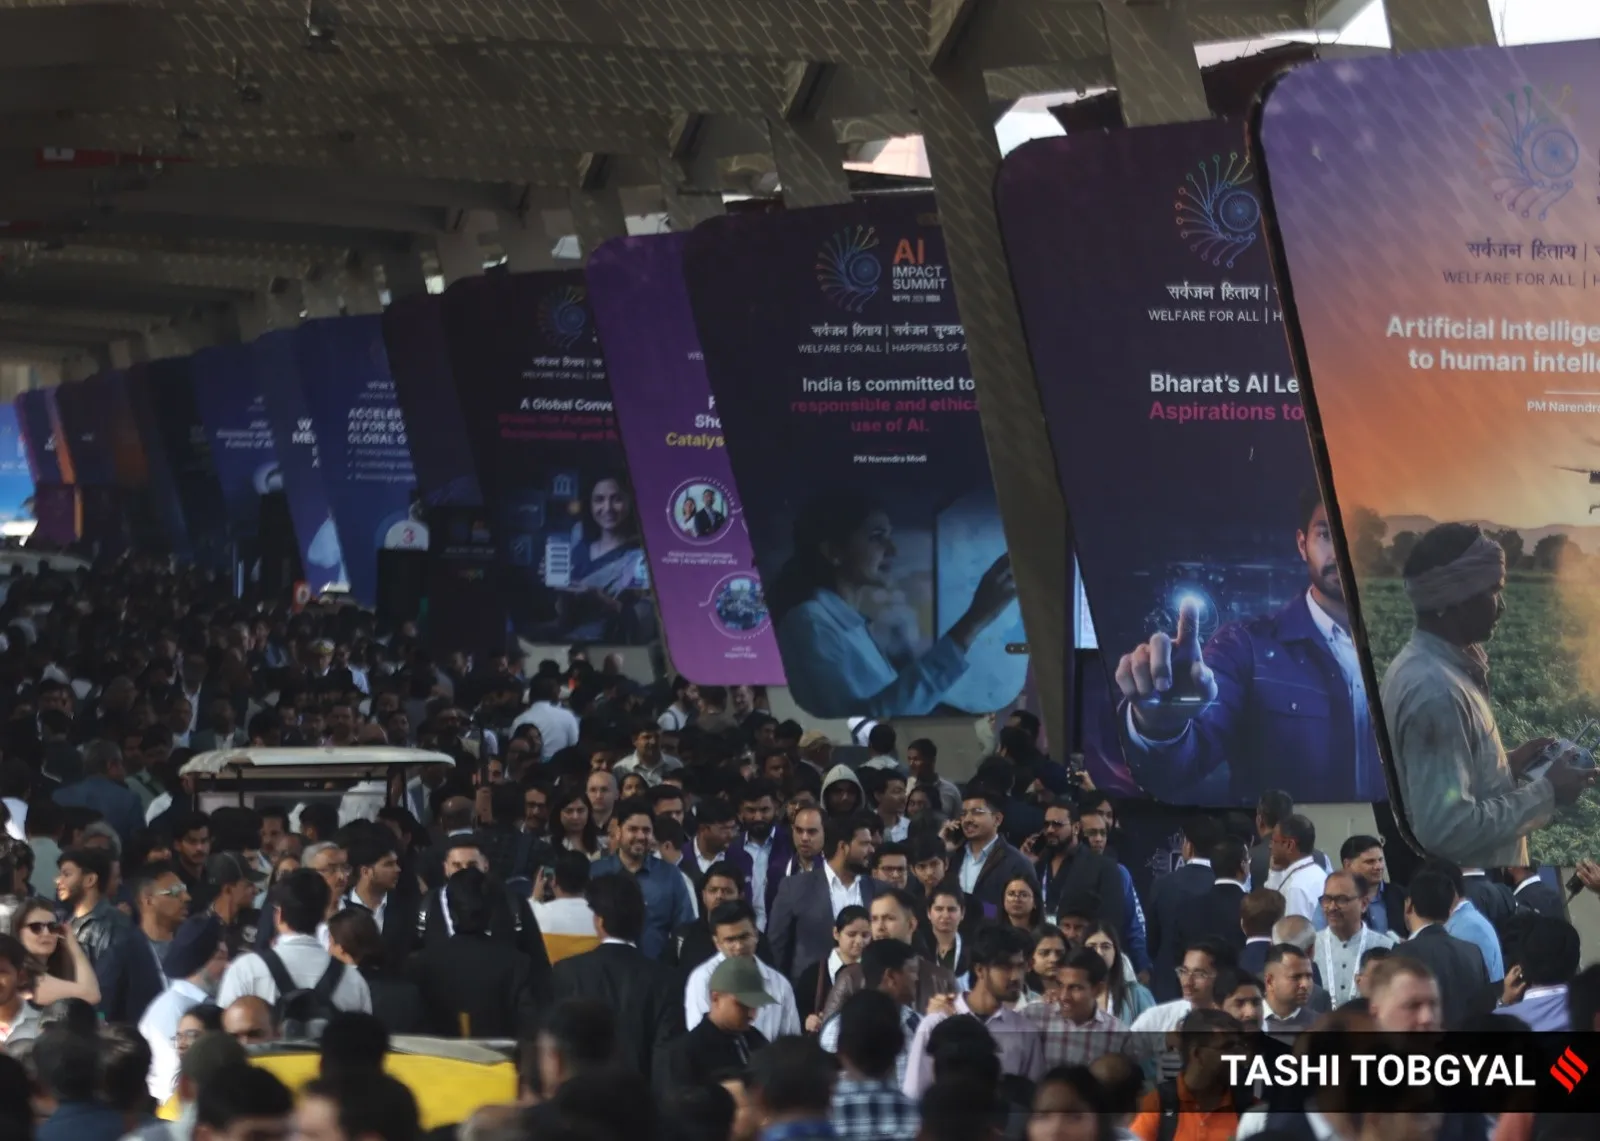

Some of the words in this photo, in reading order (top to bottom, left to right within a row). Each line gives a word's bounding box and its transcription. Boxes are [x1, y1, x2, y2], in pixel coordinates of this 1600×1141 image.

[892, 237, 925, 264] AI
[1466, 237, 1523, 259] सर्वजन
[1530, 237, 1577, 261] हिताय
[892, 265, 943, 277] IMPACT
[1442, 271, 1511, 285] WELFARE
[1516, 273, 1545, 286] FOR
[1549, 273, 1575, 286] ALL
[892, 278, 948, 290] SUMMIT
[1166, 281, 1215, 300] सर्वजन
[1220, 281, 1261, 301] हिताय
[1148, 309, 1206, 322] WELFARE
[1209, 310, 1234, 322] FOR
[1237, 310, 1260, 322] ALL
[1273, 311, 1284, 322] H
[1386, 315, 1494, 340] Artificial
[1501, 317, 1600, 348] Intellige
[797, 343, 842, 354] WELFARE
[844, 343, 863, 353] FOR
[865, 343, 883, 353] ALL
[892, 343, 945, 353] HAPPINESS
[946, 343, 960, 352] OF
[1407, 348, 1434, 370] to
[1440, 349, 1526, 371] human
[802, 376, 842, 392] India
[847, 376, 861, 392] is
[865, 376, 955, 392] committed
[959, 377, 976, 391] to
[1245, 374, 1268, 393] AI
[520, 397, 529, 410] A
[532, 397, 574, 411] Global
[791, 397, 891, 417] responsible
[895, 397, 927, 411] and
[1527, 400, 1546, 412] PM
[1149, 400, 1276, 424] Aspirations
[1282, 402, 1304, 421] to
[850, 420, 882, 432] use
[886, 417, 903, 432] of
[907, 417, 929, 432] AI.
[348, 432, 396, 445] GLOBAL
[666, 432, 726, 450] Catalys
[853, 454, 867, 464] PM
[868, 453, 905, 464] Narendra
[906, 453, 928, 463] Modi
